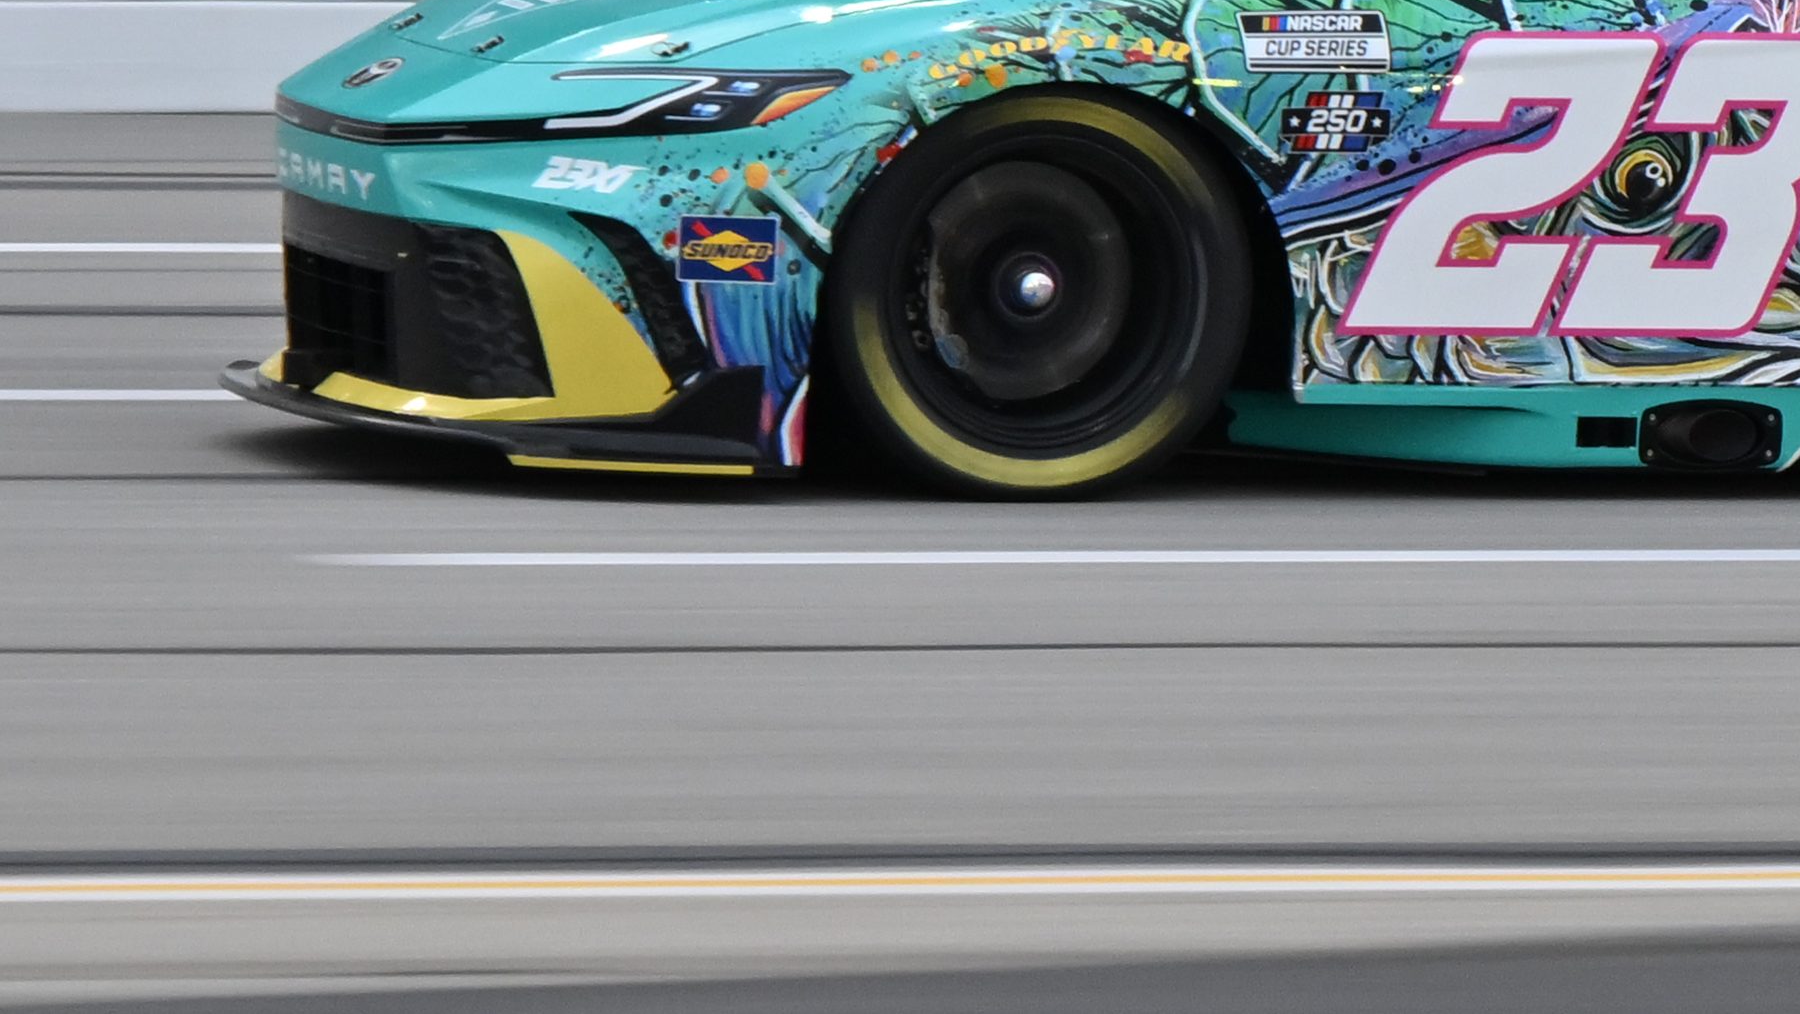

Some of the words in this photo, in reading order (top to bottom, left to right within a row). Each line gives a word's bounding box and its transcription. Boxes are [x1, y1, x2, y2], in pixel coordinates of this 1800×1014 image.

[1286, 15, 1364, 32] NASCAR
[1265, 39, 1301, 57] CUP
[1304, 39, 1369, 57] SERIES
[1306, 109, 1368, 133] 250
[685, 242, 770, 260] SUNOCO
